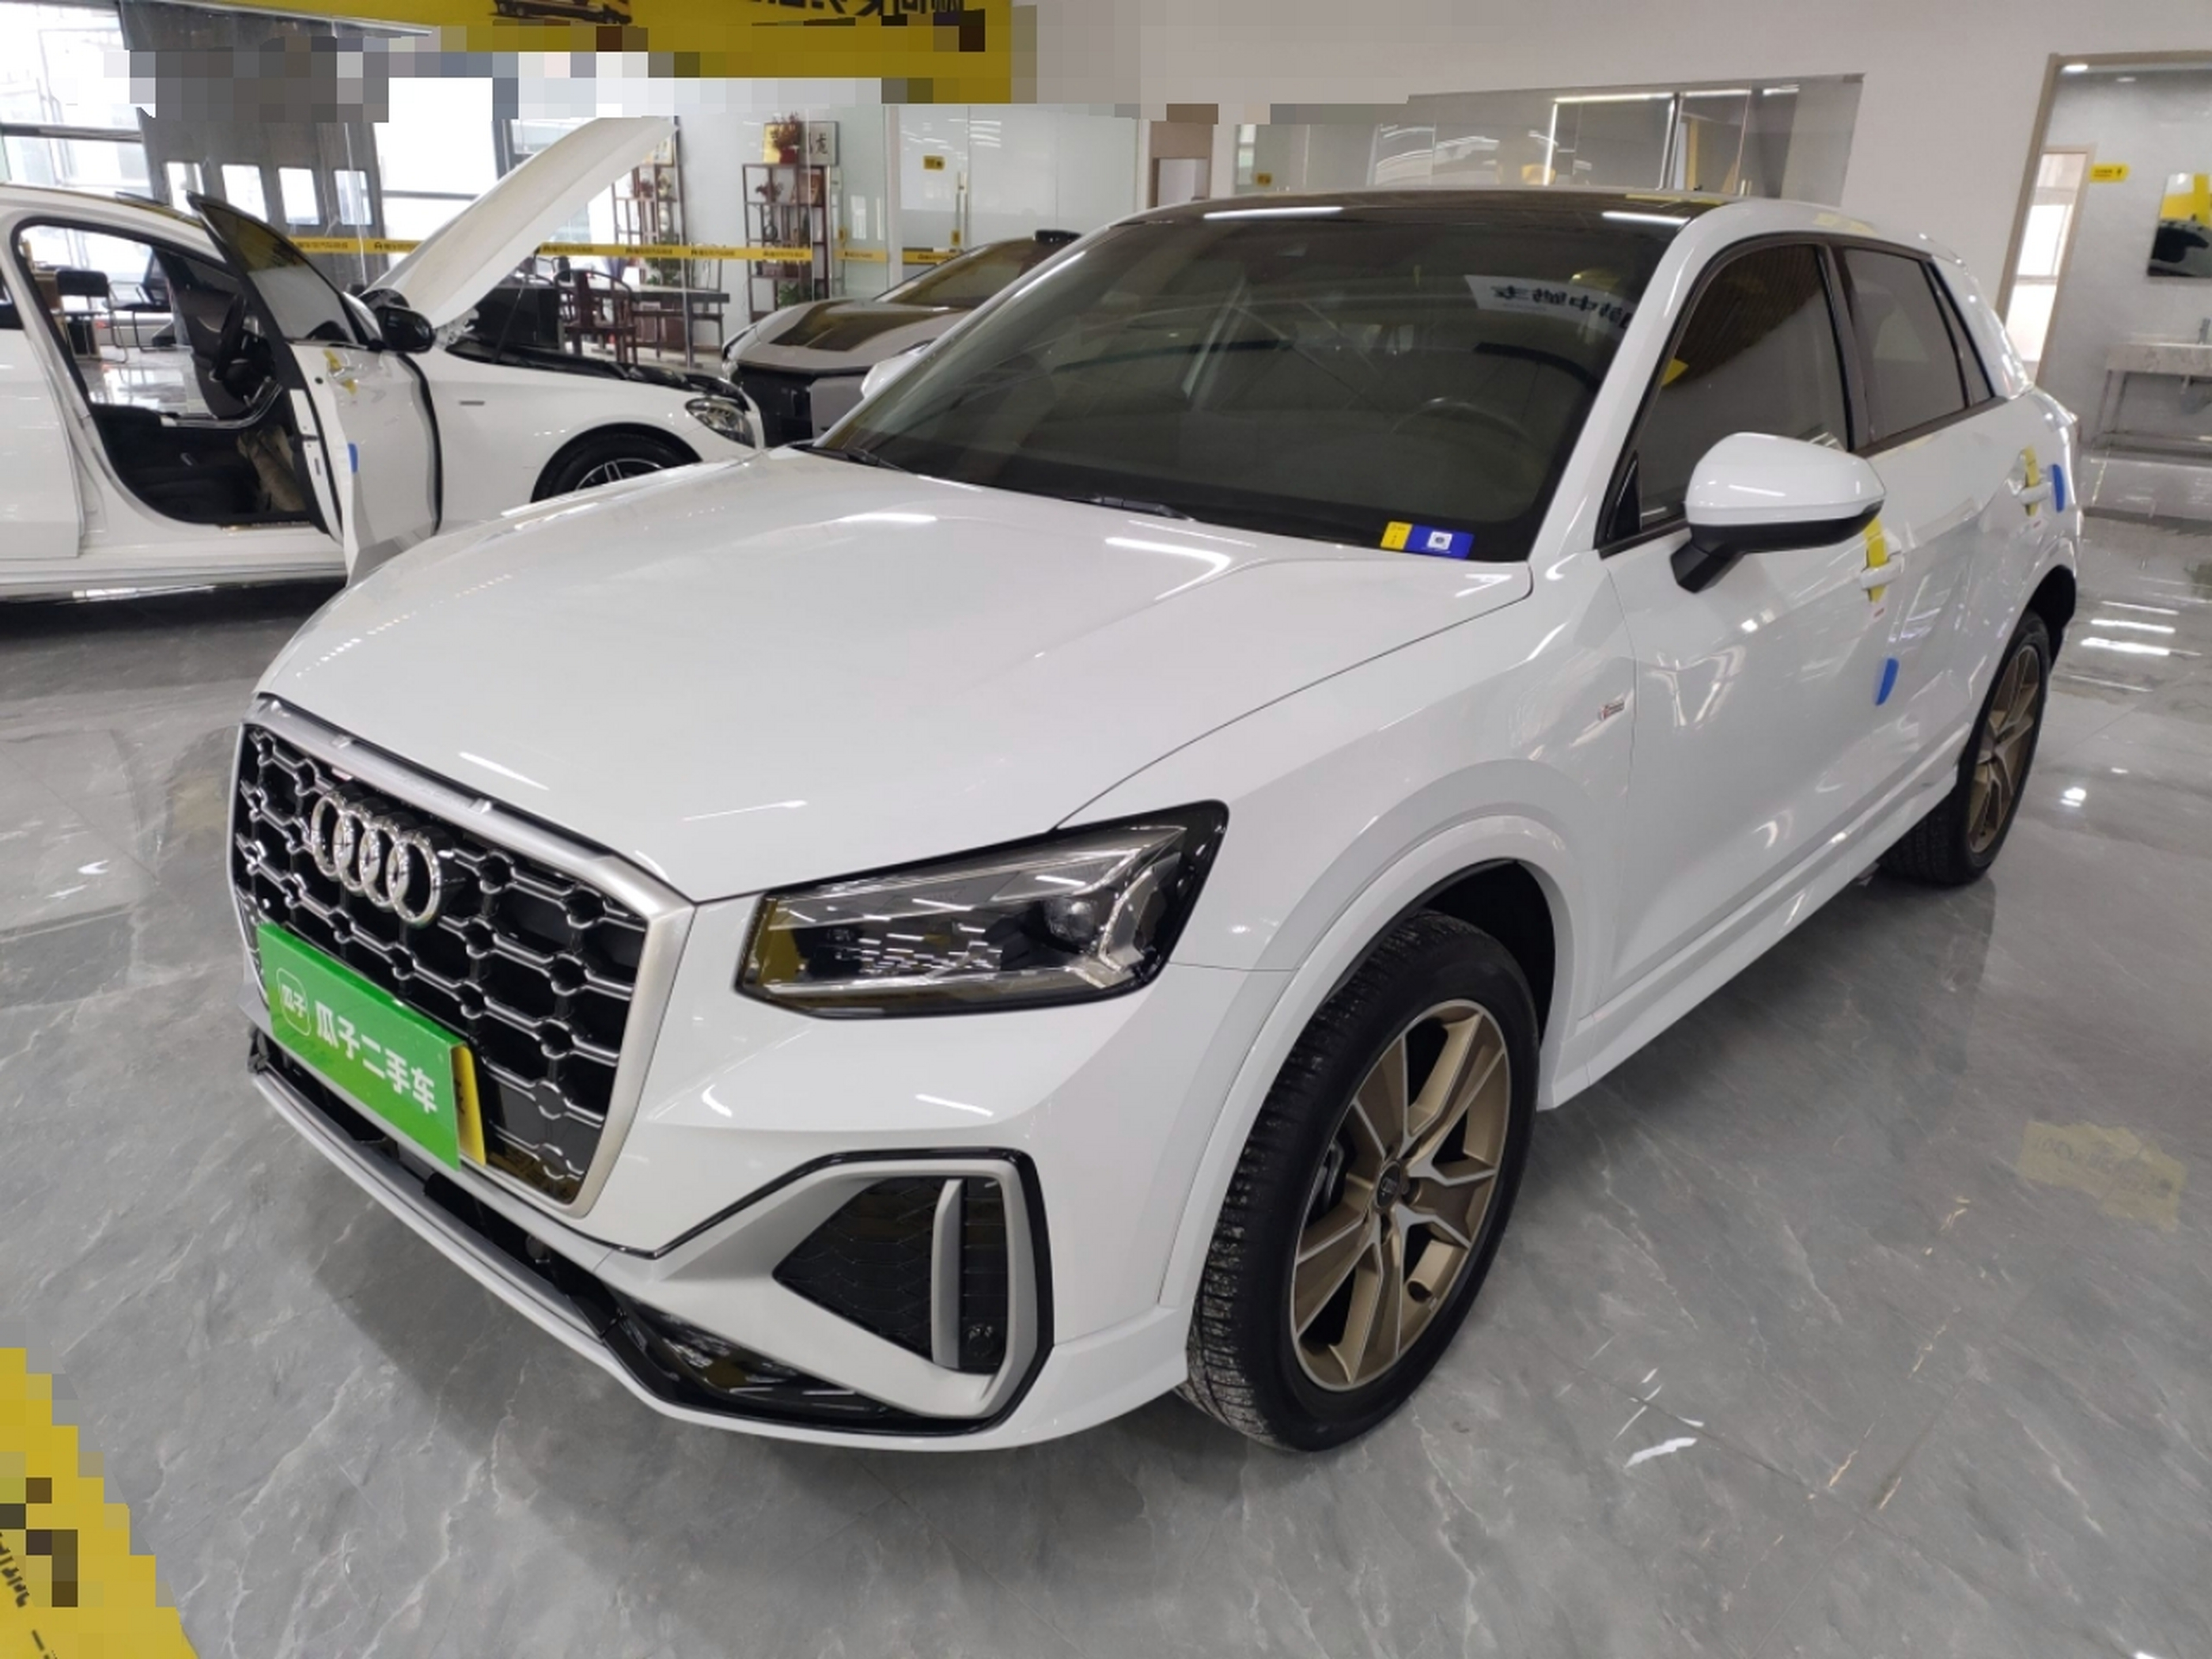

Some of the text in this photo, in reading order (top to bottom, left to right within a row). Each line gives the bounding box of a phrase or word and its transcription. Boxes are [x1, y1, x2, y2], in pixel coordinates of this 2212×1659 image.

[281, 983, 308, 1018] 瓜子
[315, 1000, 438, 1114] 瓜子二手车
